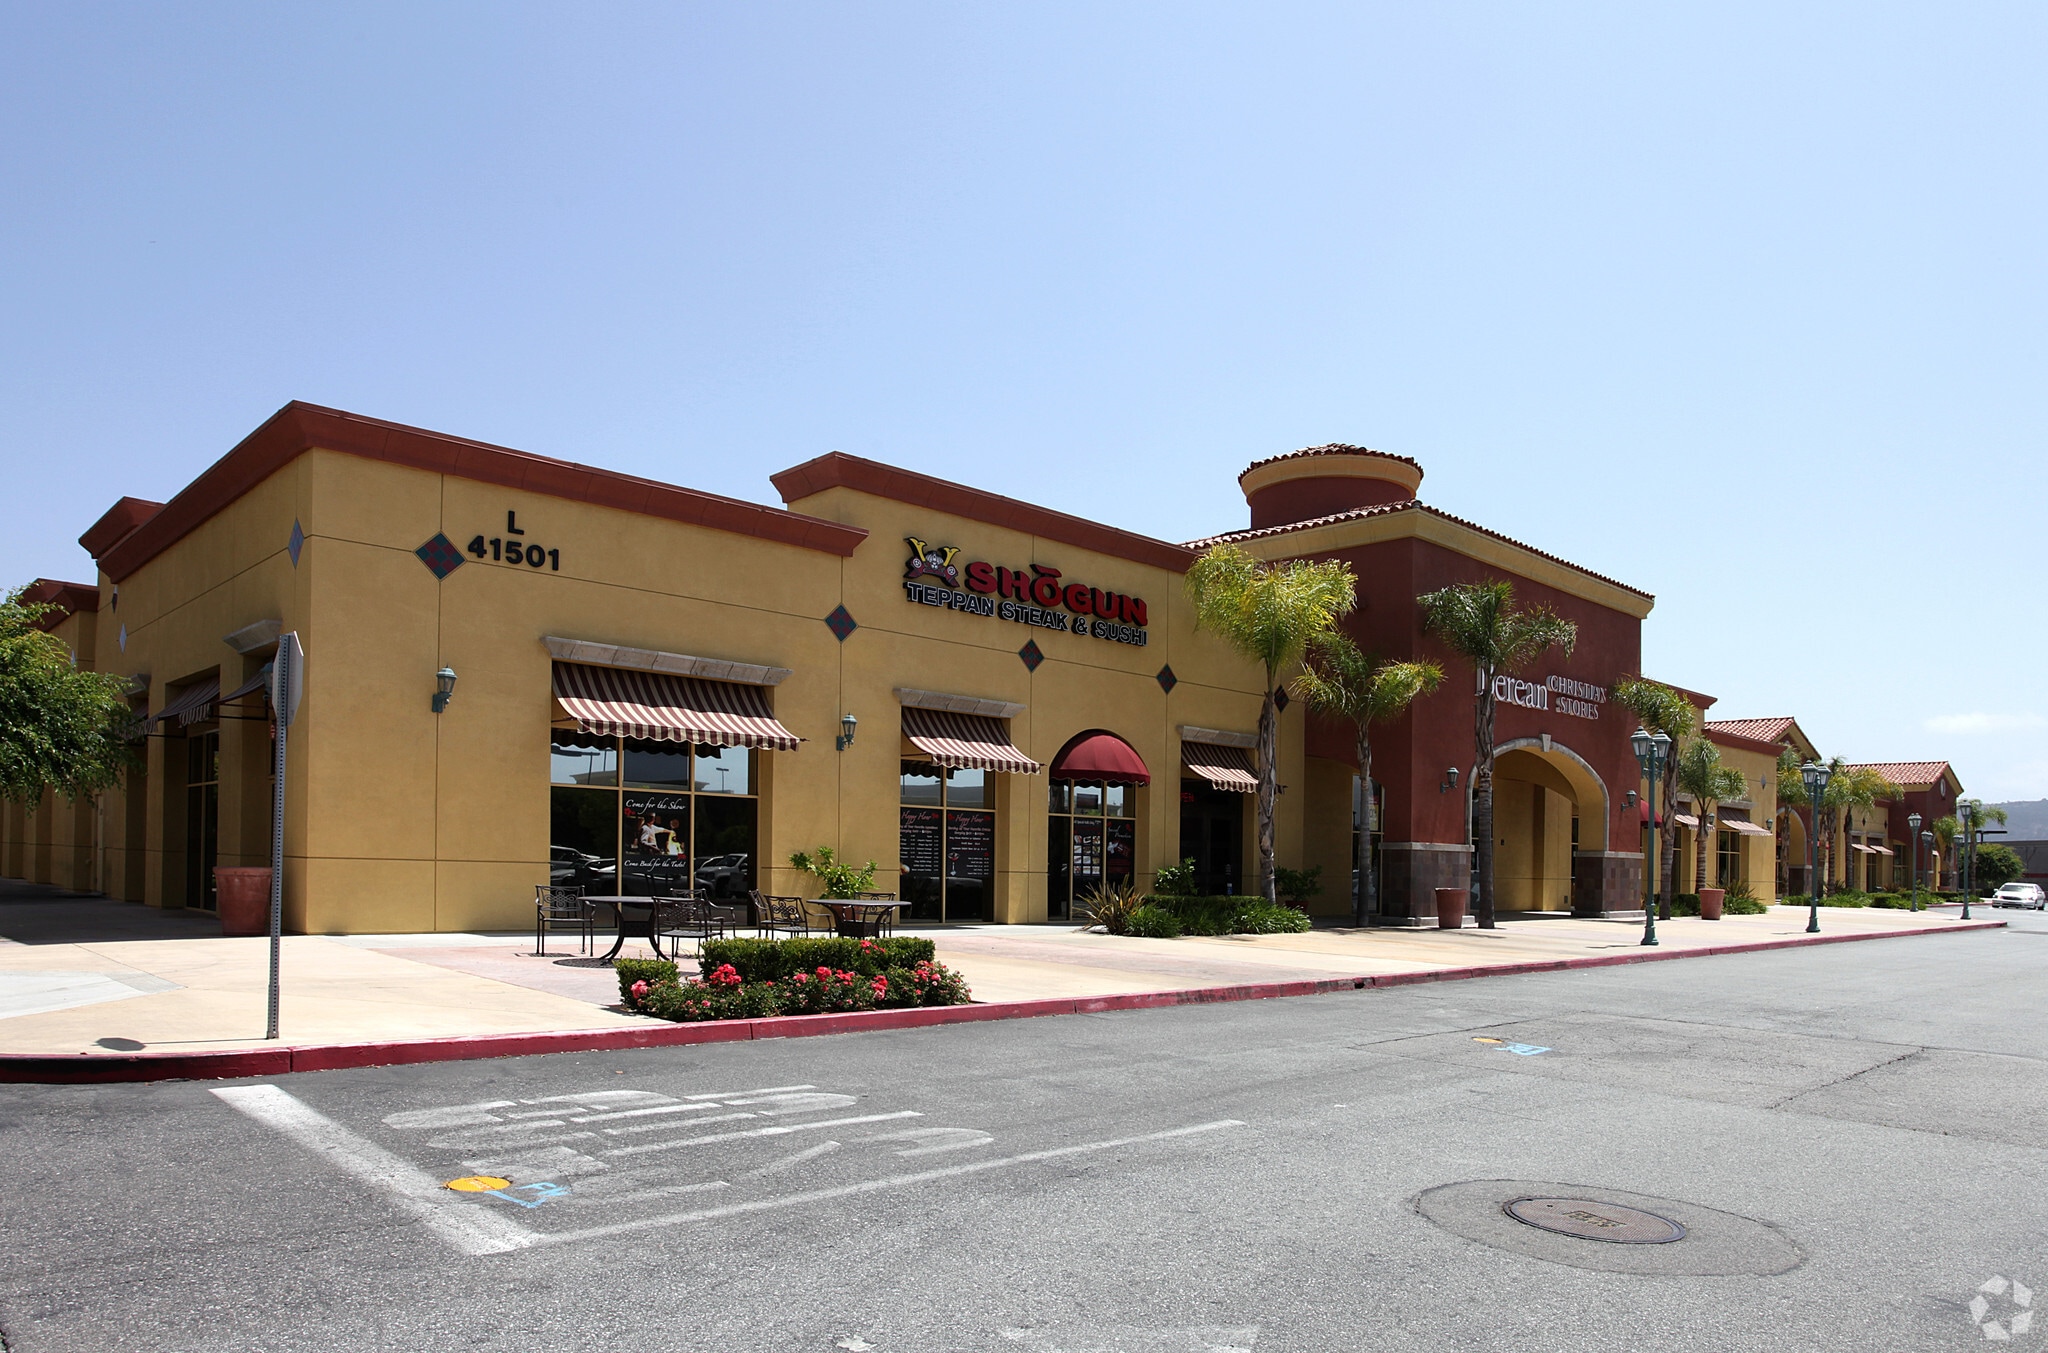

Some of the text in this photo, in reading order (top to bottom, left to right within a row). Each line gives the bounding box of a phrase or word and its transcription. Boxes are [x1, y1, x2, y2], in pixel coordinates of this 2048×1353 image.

[507, 510, 525, 535] L
[467, 535, 560, 571] 41501
[966, 561, 1148, 627] SHŌGUN
[904, 581, 1147, 646] TEPPAN STEAK & SUSHI
[1547, 674, 1607, 703] CHRISTIAN
[1556, 696, 1599, 719] STORES
[625, 797, 686, 815] Come for the Show
